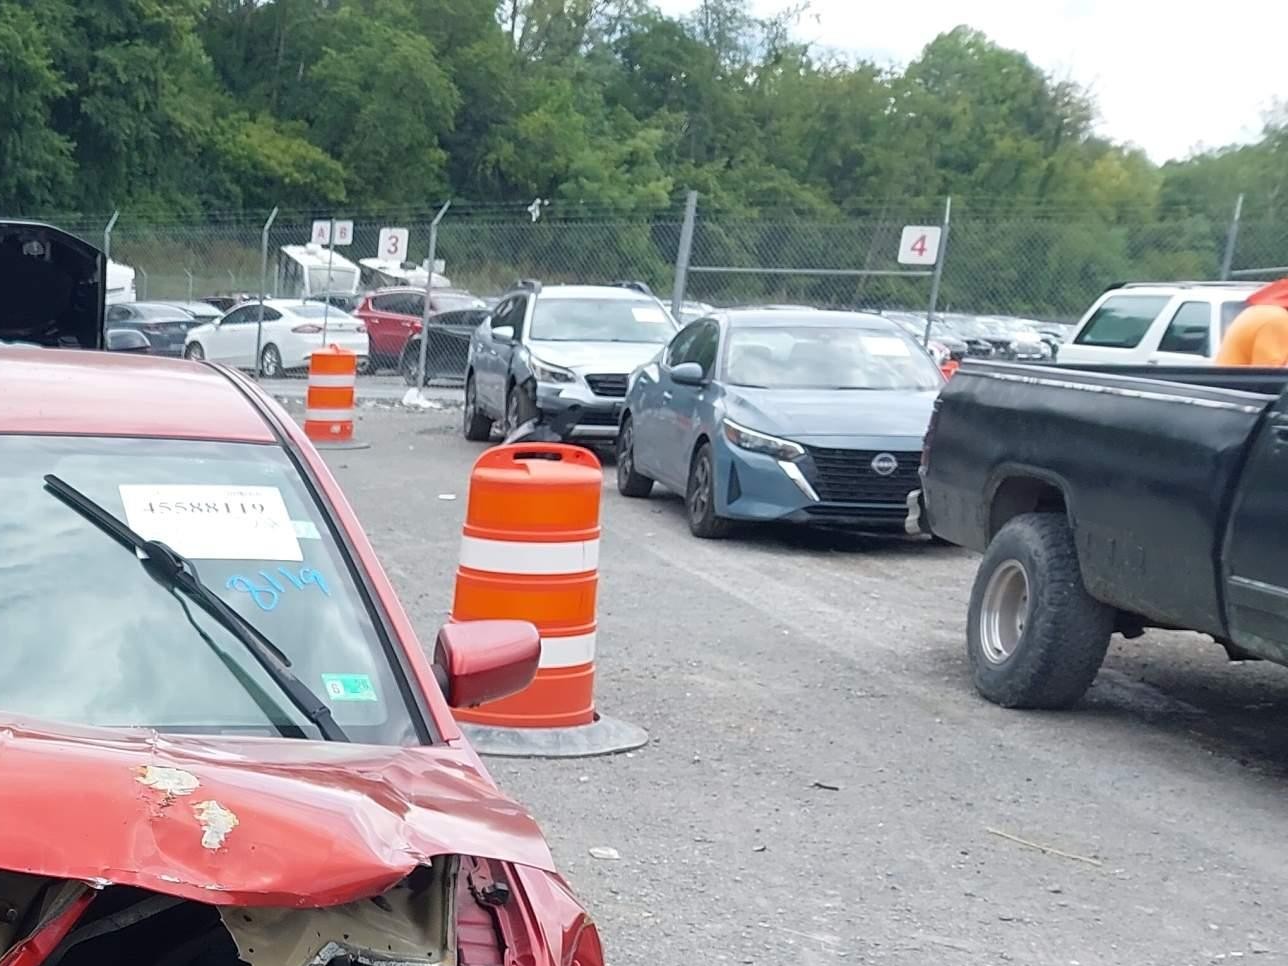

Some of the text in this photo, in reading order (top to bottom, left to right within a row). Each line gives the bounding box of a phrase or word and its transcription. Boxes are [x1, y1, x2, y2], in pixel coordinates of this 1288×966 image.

[387, 235, 399, 254] 3
[910, 234, 927, 256] 4
[142, 500, 266, 516] 45588119
